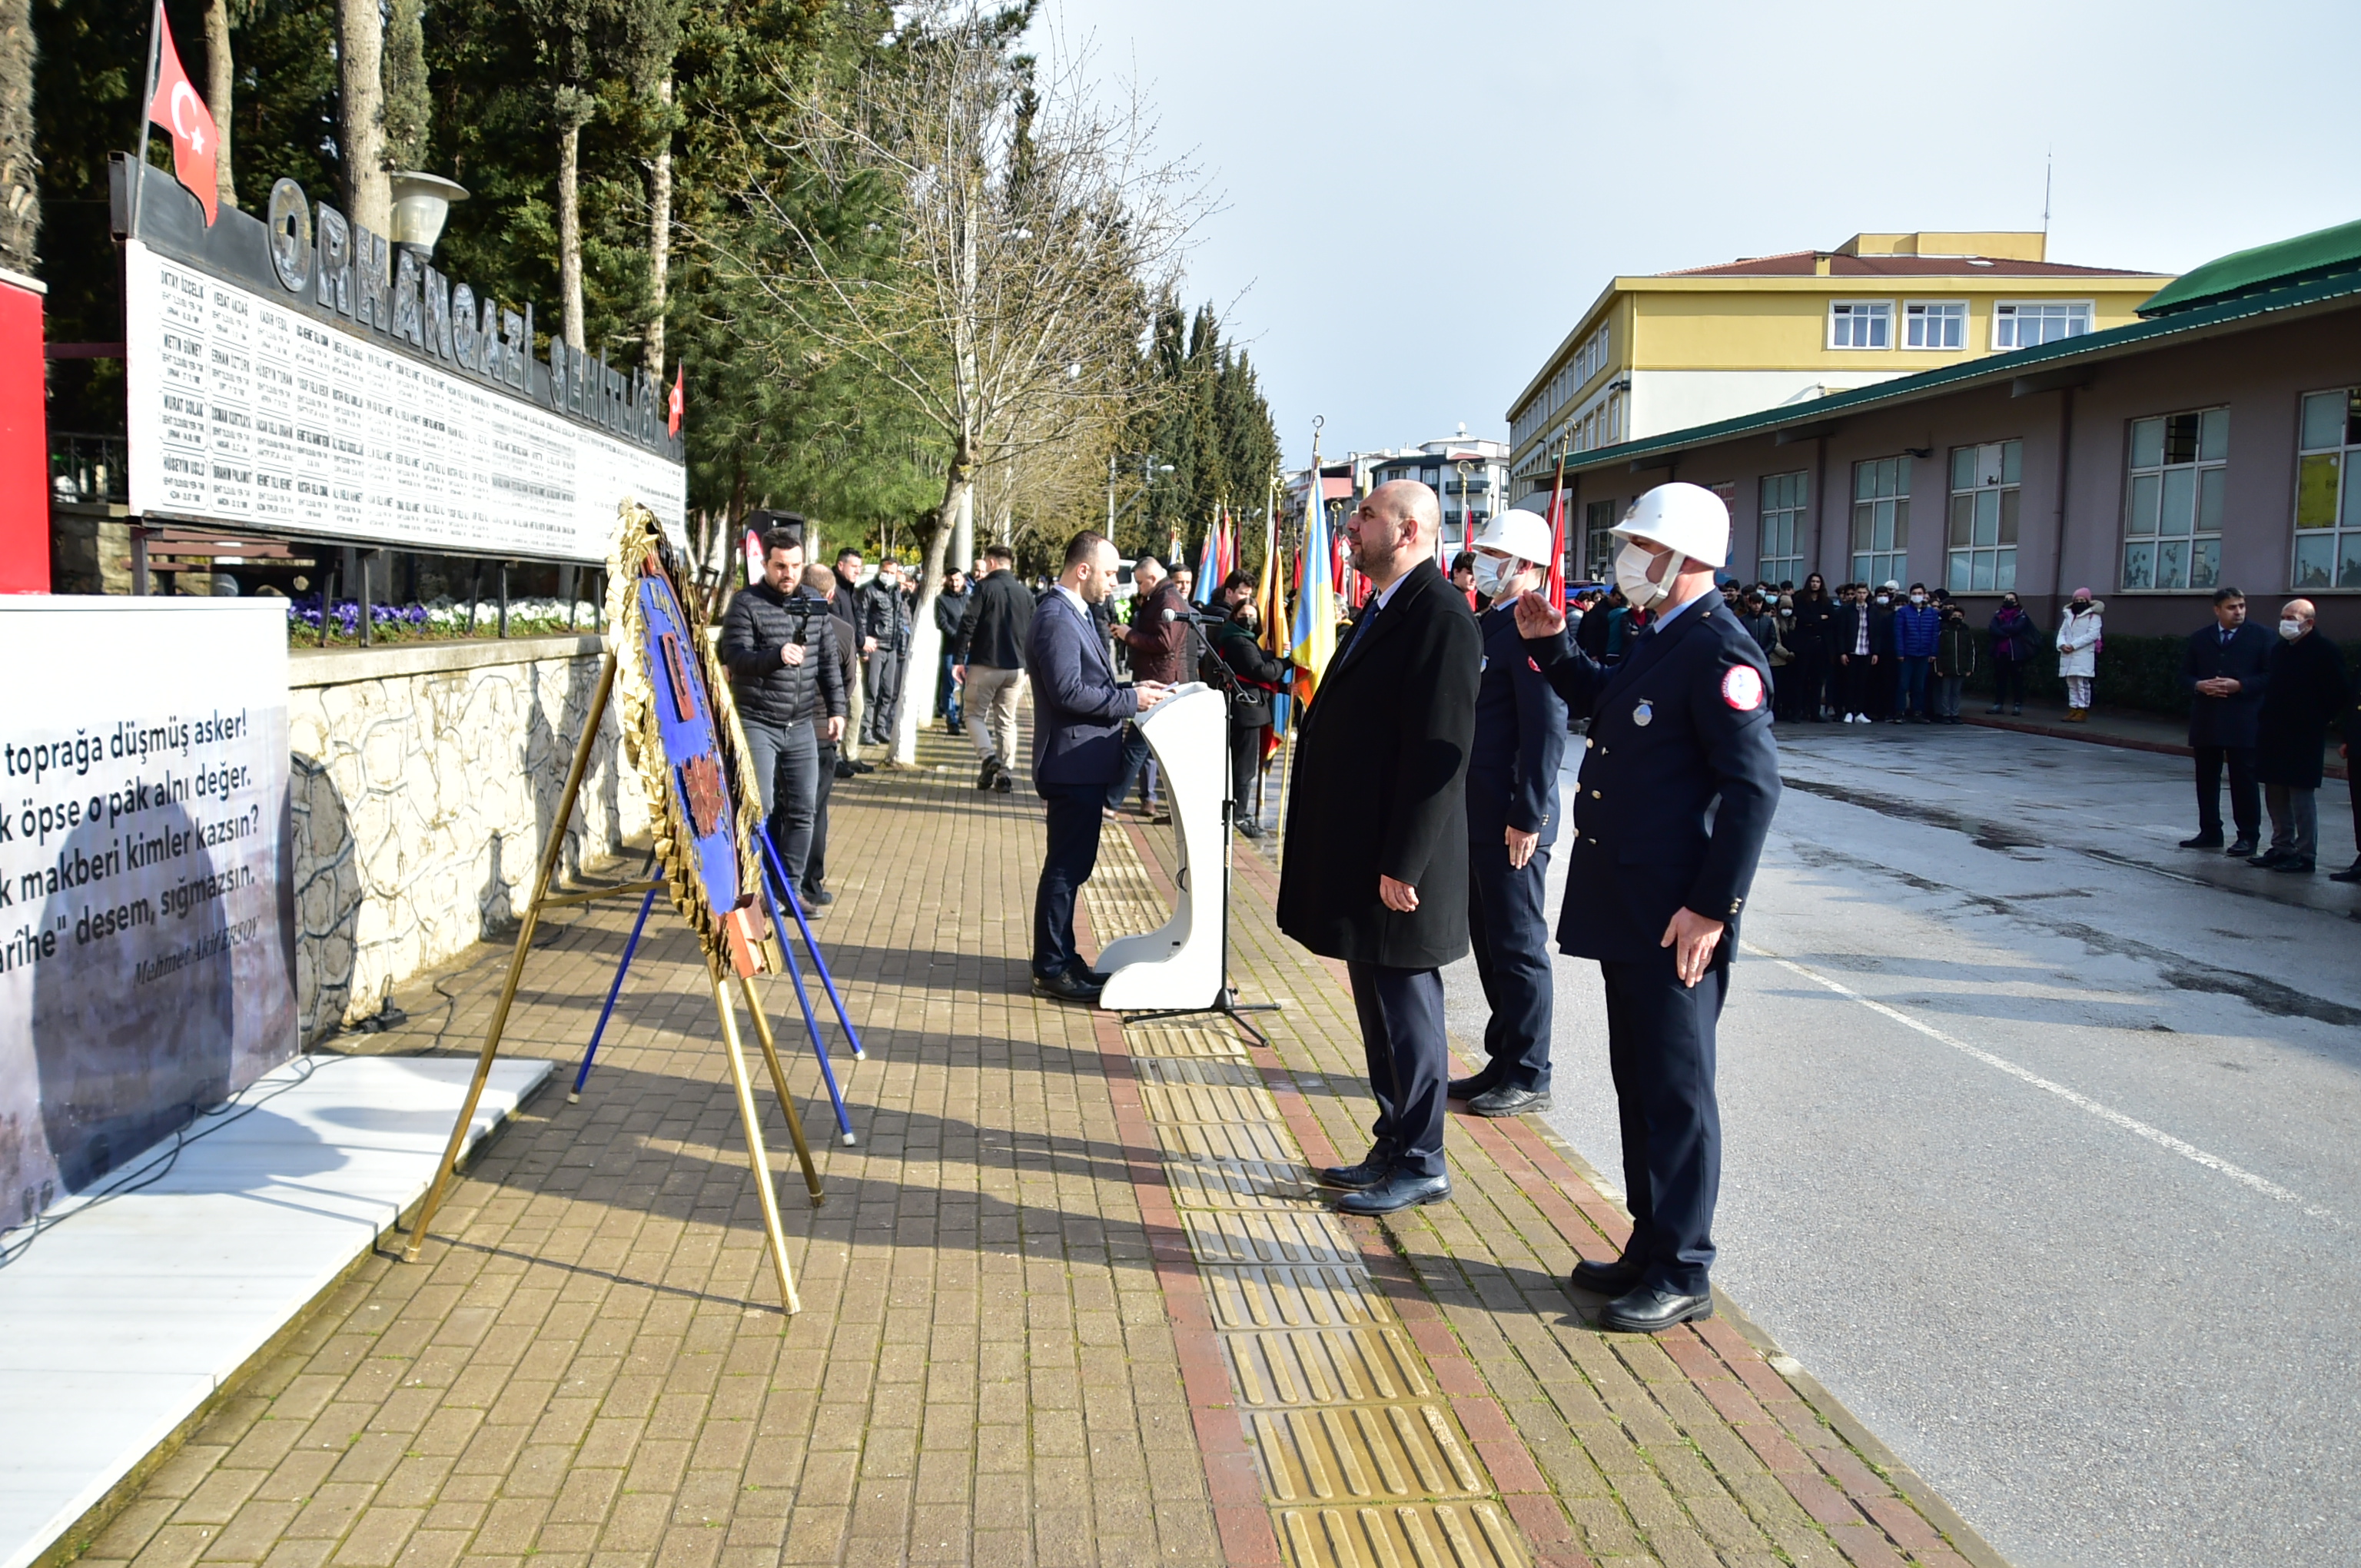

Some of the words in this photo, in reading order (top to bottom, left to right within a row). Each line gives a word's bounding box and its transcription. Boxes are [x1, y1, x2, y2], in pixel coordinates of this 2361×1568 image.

[267, 178, 533, 395] ORHANGAZİ
[5, 728, 103, 784] toprağa
[111, 716, 188, 764] düşmüş
[194, 707, 246, 744] asker!
[22, 798, 80, 846] öpse
[88, 796, 101, 822] o
[109, 776, 148, 829] pâk
[154, 769, 189, 807] alnı
[195, 760, 251, 801] değer.
[21, 839, 119, 902] makberi
[126, 825, 191, 871] kimler
[195, 804, 259, 850] kazsın?
[77, 898, 155, 945] desem,
[161, 865, 254, 919] sığmazsın.
[134, 946, 191, 988] Mehmet
[194, 932, 220, 961] Akif
[221, 915, 261, 951] ERSOY
